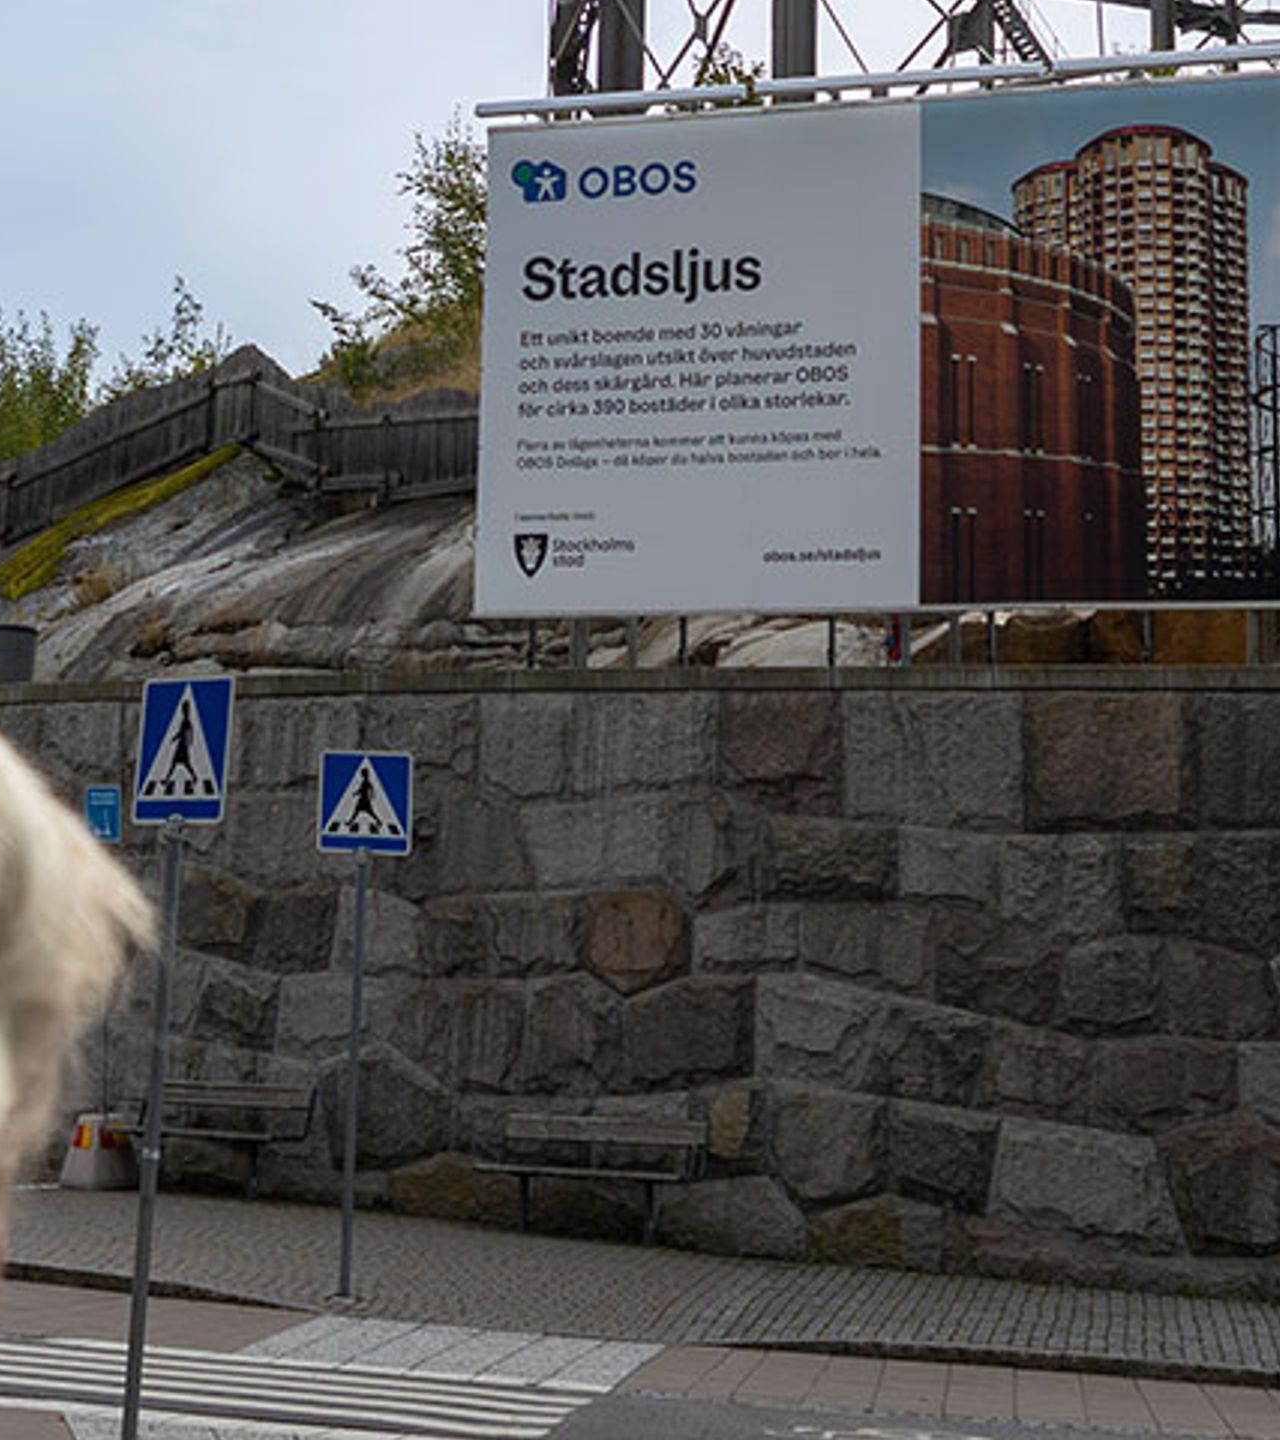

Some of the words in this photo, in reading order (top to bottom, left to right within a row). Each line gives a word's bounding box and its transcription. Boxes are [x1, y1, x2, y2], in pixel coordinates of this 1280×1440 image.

[578, 160, 697, 199] OBOS
[521, 246, 762, 304] Stadsljus
[519, 330, 543, 347] Ett
[547, 329, 590, 345] unikt
[592, 326, 655, 344] boende
[658, 324, 696, 341] med
[700, 322, 722, 340] 30
[725, 321, 803, 339] våningar
[518, 354, 550, 371] och
[553, 351, 643, 369] svårslagen
[646, 348, 695, 365] utsikt
[698, 346, 739, 364] över
[742, 342, 857, 361] huvudstaden
[518, 378, 548, 394] och
[552, 377, 590, 393] dess
[593, 372, 675, 393] skärgård.
[678, 371, 712, 387] Här
[715, 370, 792, 390] planerar
[795, 364, 849, 383] OBOS
[518, 401, 543, 418] för
[546, 400, 590, 417] cirka
[592, 398, 626, 415] 390
[628, 396, 706, 414] bostäder
[719, 393, 761, 411] olika
[764, 390, 851, 409] storlekar.
[552, 536, 635, 552] Stockholms
[762, 547, 882, 563] obos.se/stadsljus
[552, 553, 585, 568] stad
